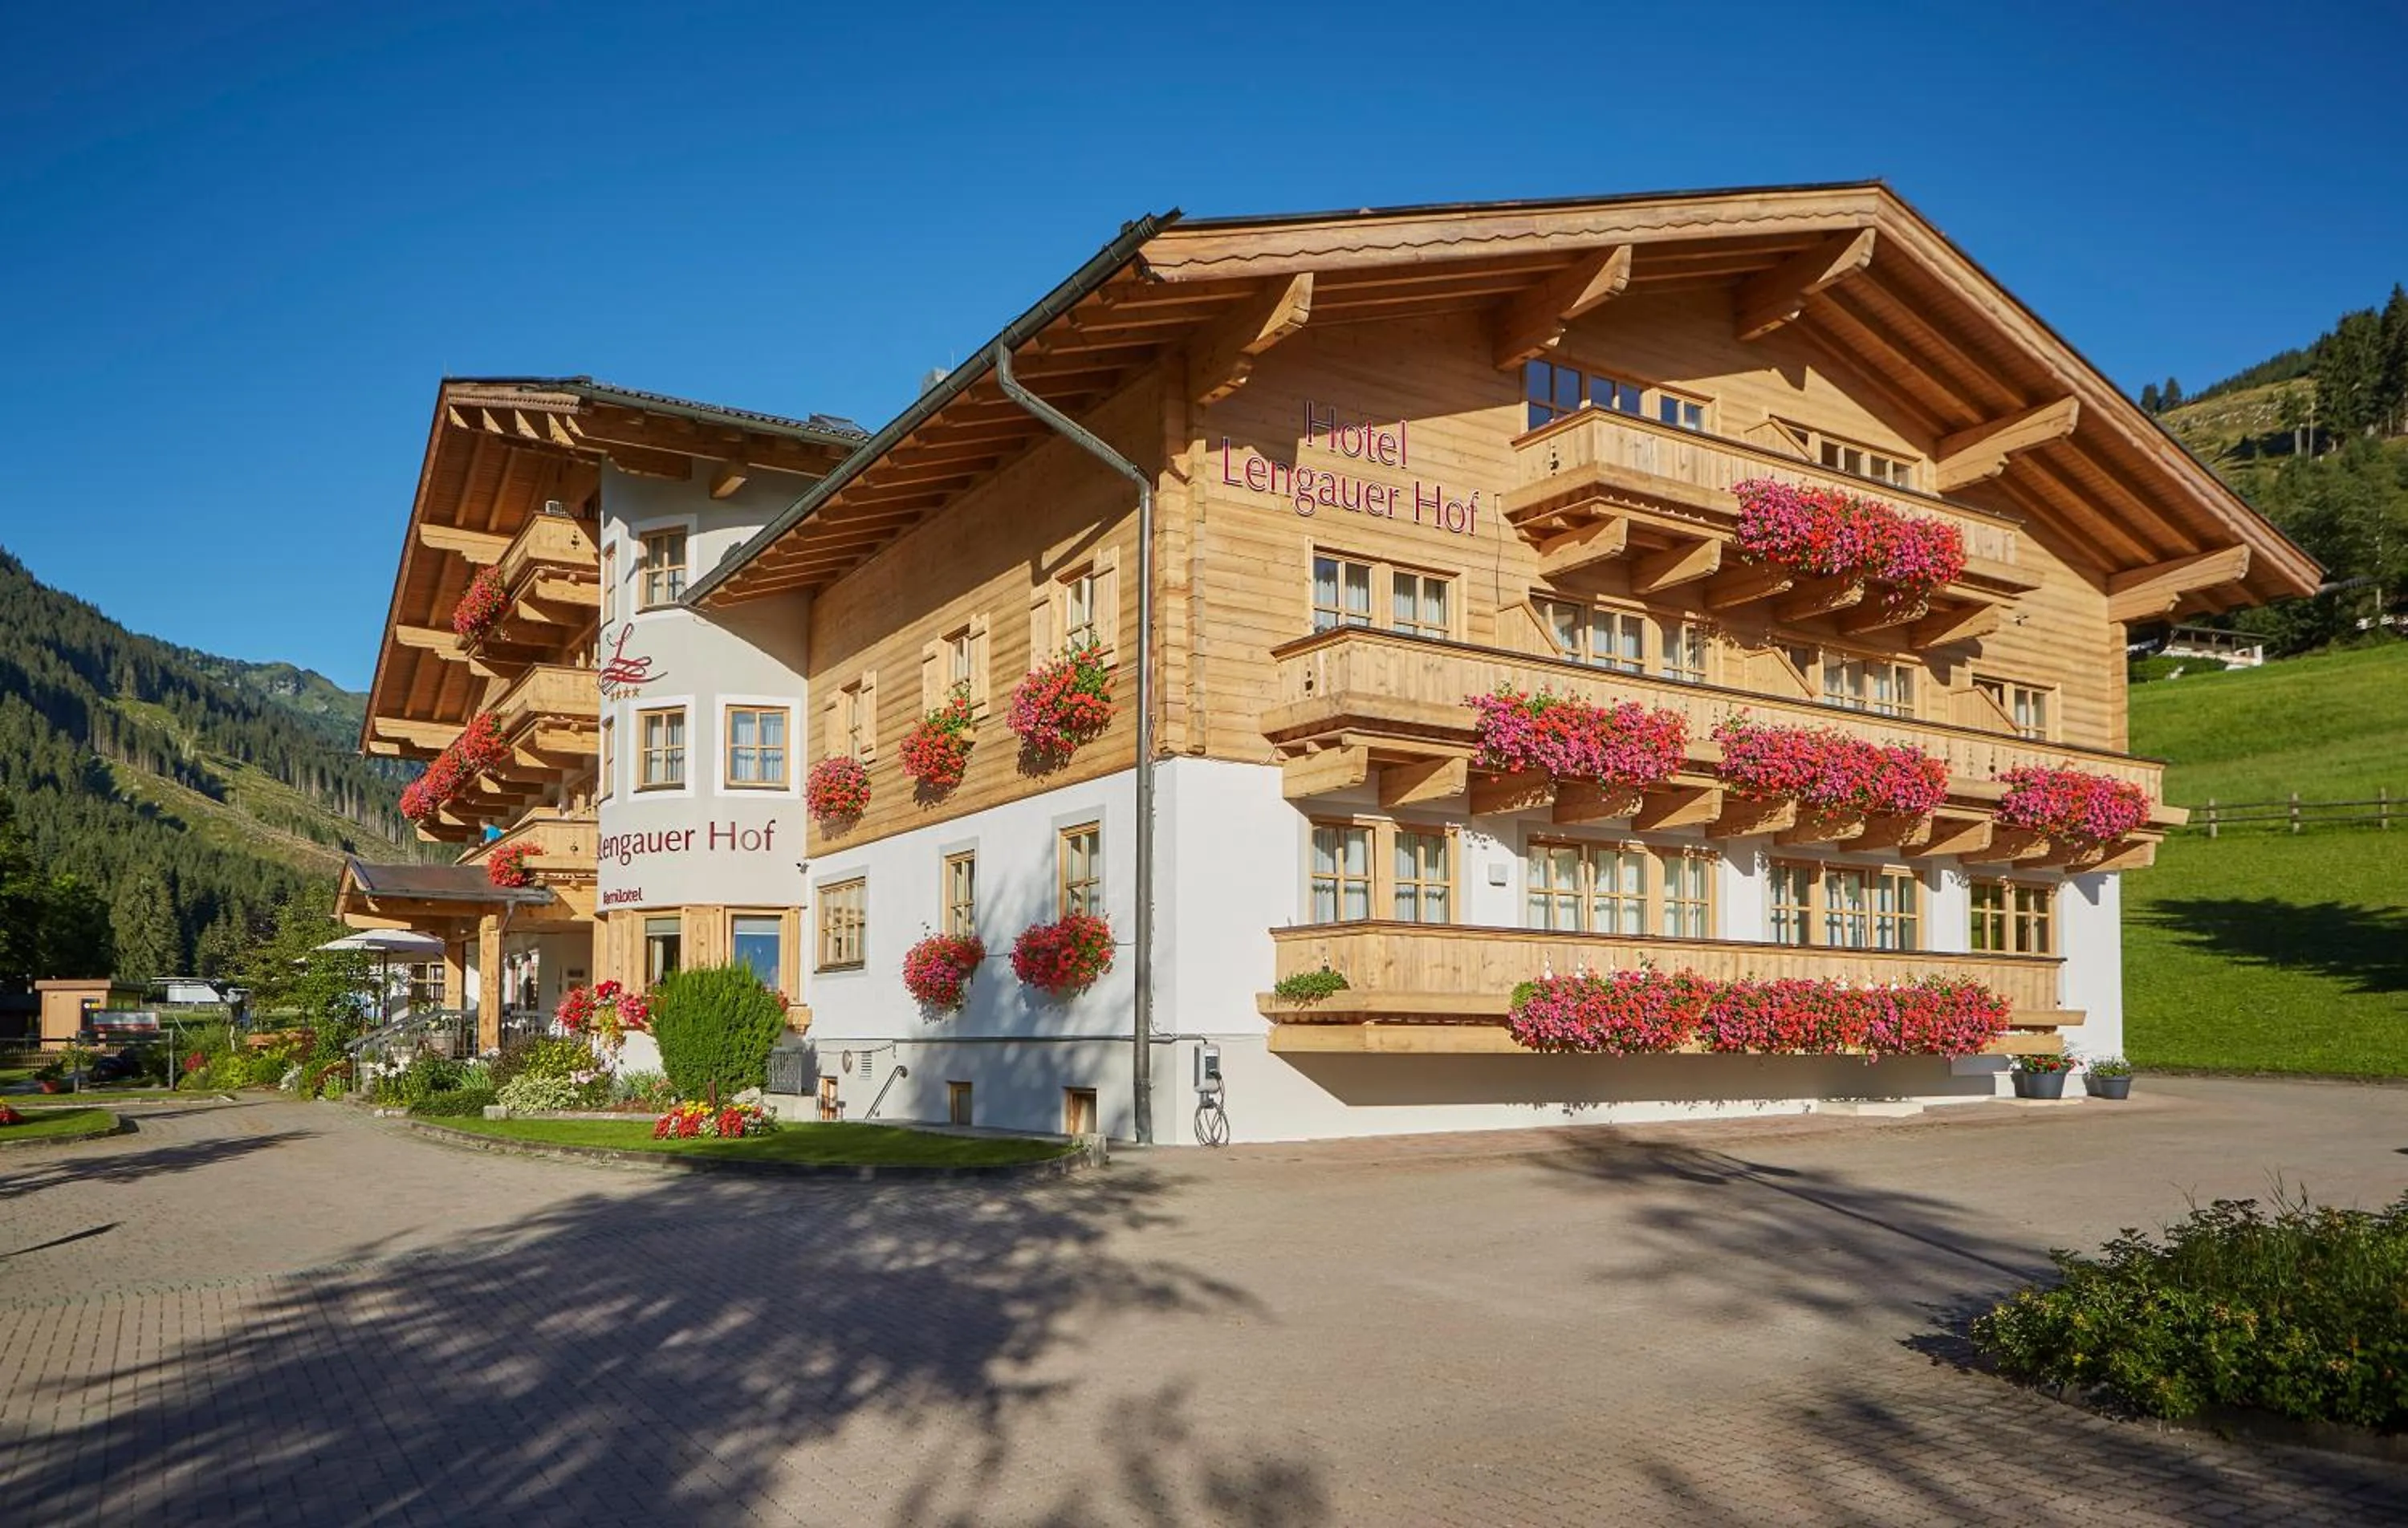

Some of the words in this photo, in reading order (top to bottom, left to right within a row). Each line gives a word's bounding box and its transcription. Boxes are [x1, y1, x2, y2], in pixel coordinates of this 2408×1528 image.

[1305, 400, 1408, 469] Hotel
[1222, 436, 1400, 518] Lengauer
[1413, 481, 1480, 536] Hof
[709, 819, 776, 851] Hof
